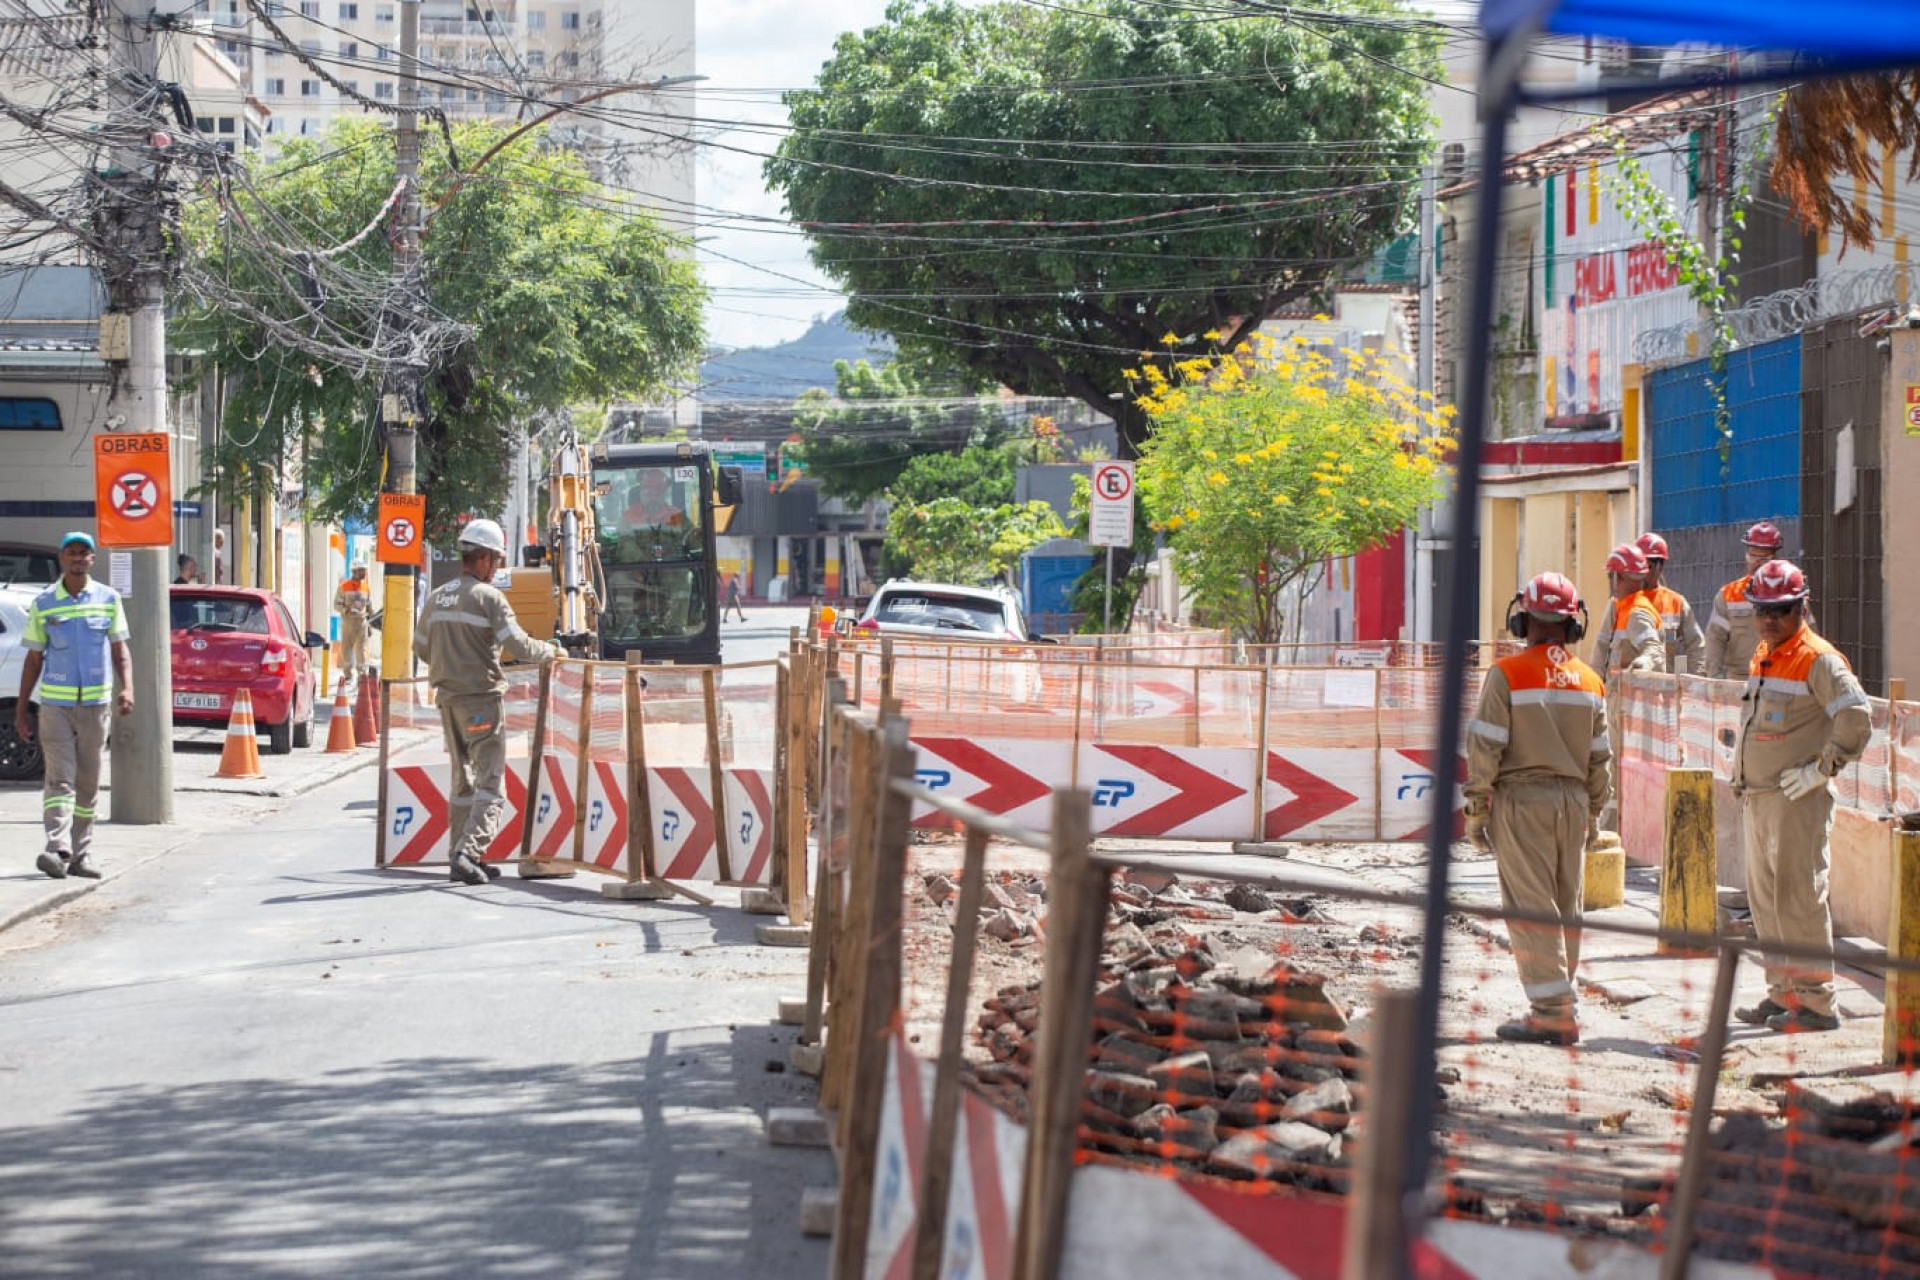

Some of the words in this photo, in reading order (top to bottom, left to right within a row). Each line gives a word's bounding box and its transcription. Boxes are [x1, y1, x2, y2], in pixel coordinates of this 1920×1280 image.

[101, 437, 163, 453] OBRAS
[384, 496, 420, 506] OBRAS
[435, 593, 460, 607] Light
